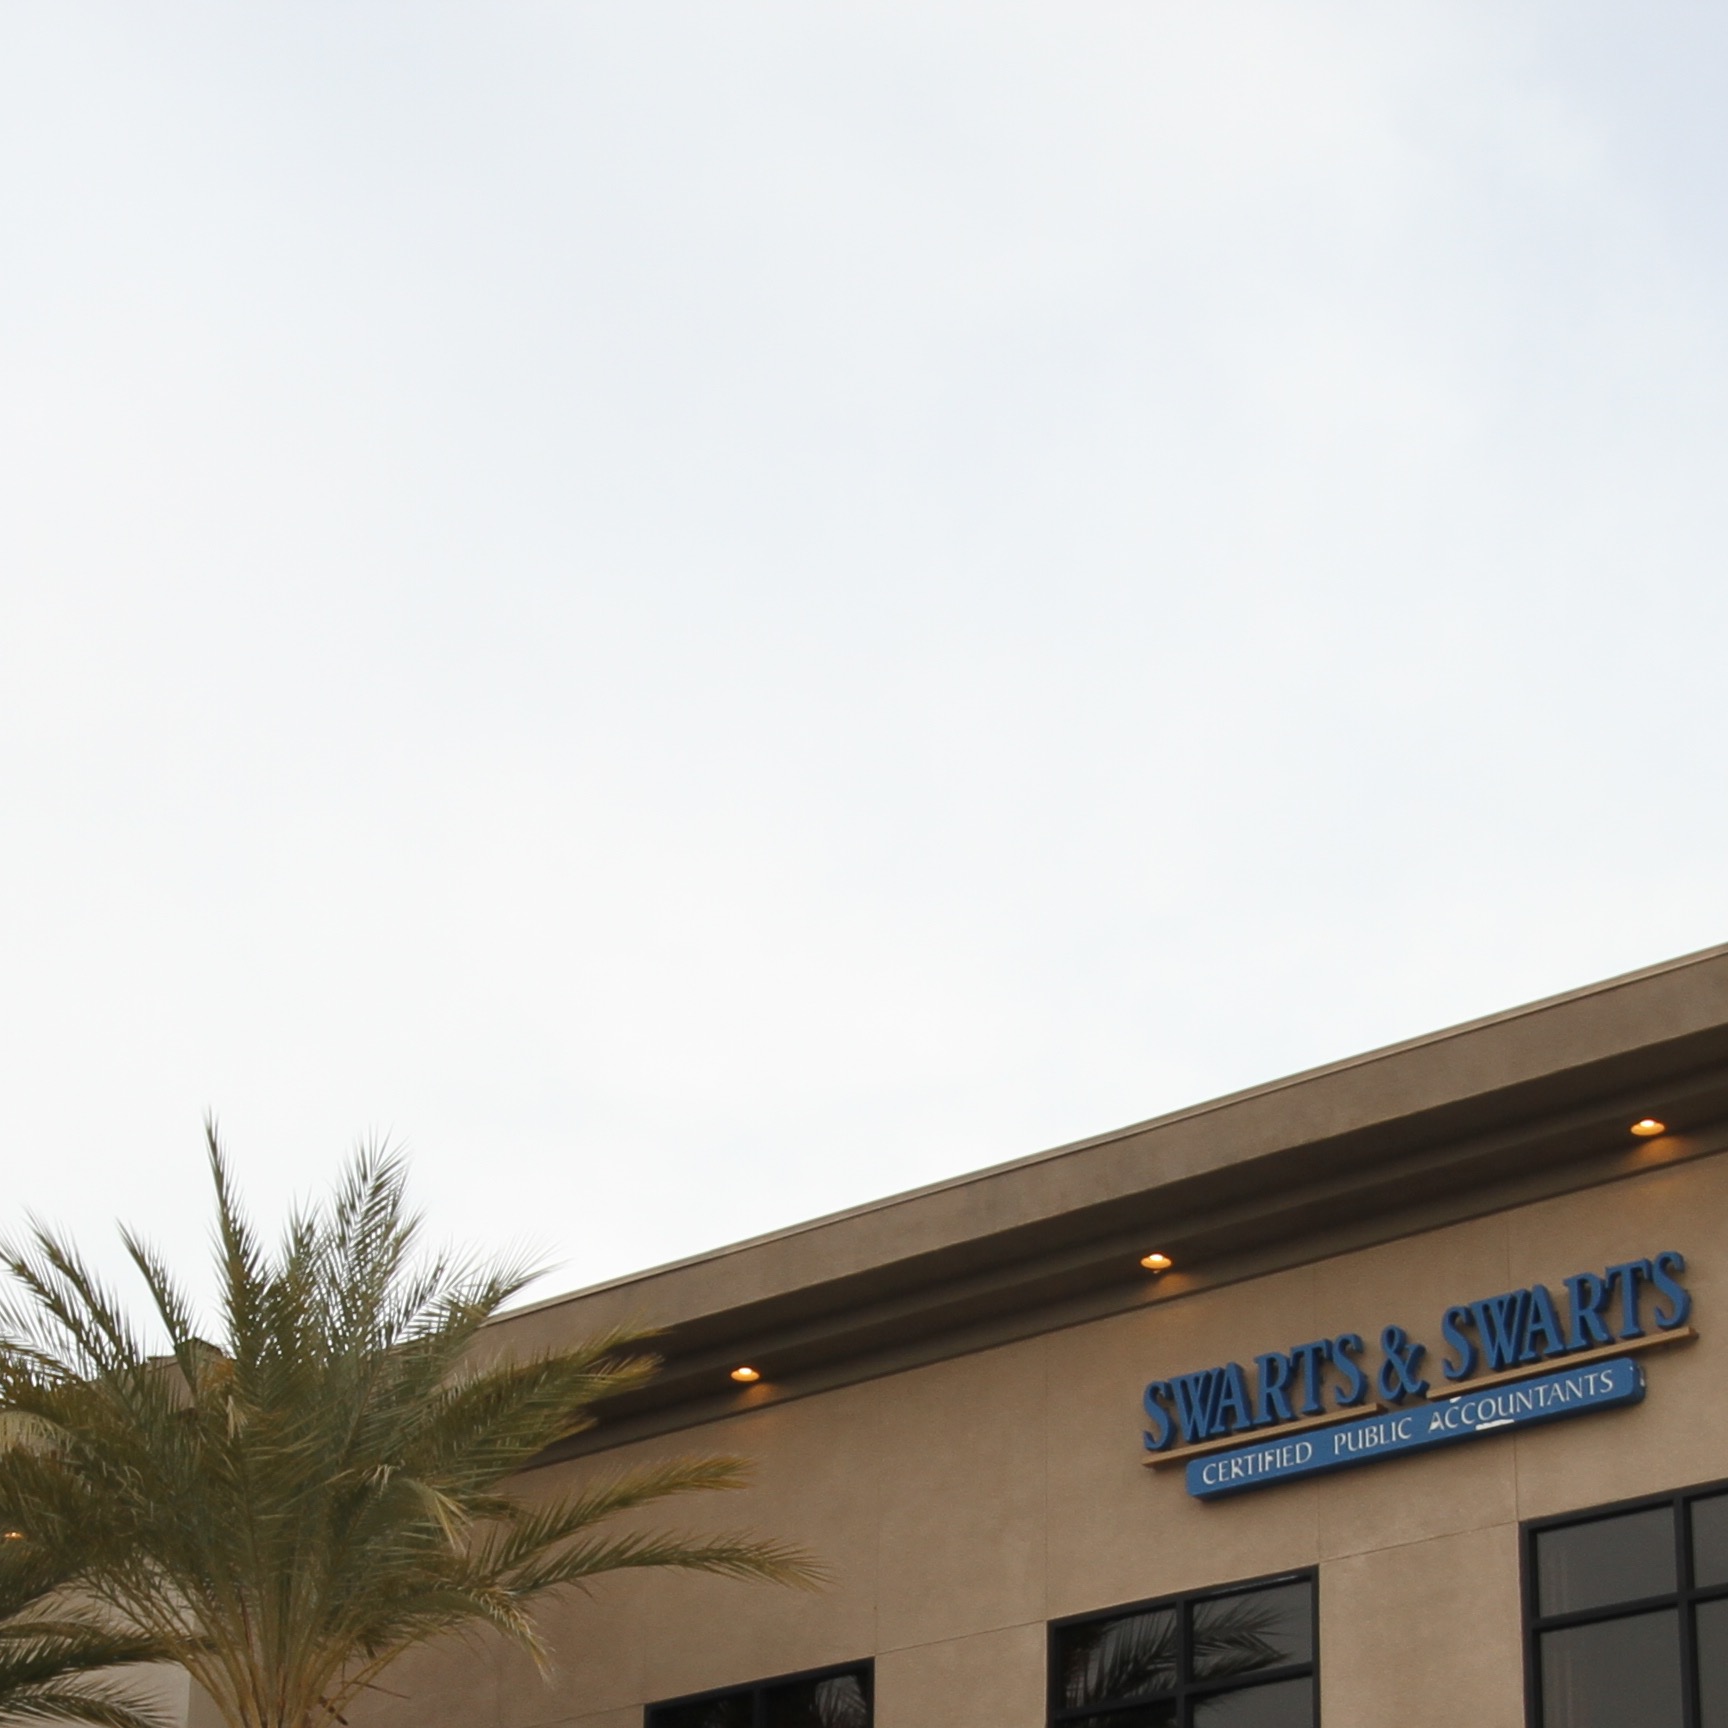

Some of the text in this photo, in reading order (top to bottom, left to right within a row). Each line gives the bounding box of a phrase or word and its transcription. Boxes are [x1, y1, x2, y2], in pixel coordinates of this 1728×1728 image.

[1142, 1250, 1692, 1453] SWARTS & SWARTS
[1201, 1369, 1615, 1486] CERTIFIED PUBLIC ACCOUNTANTS
